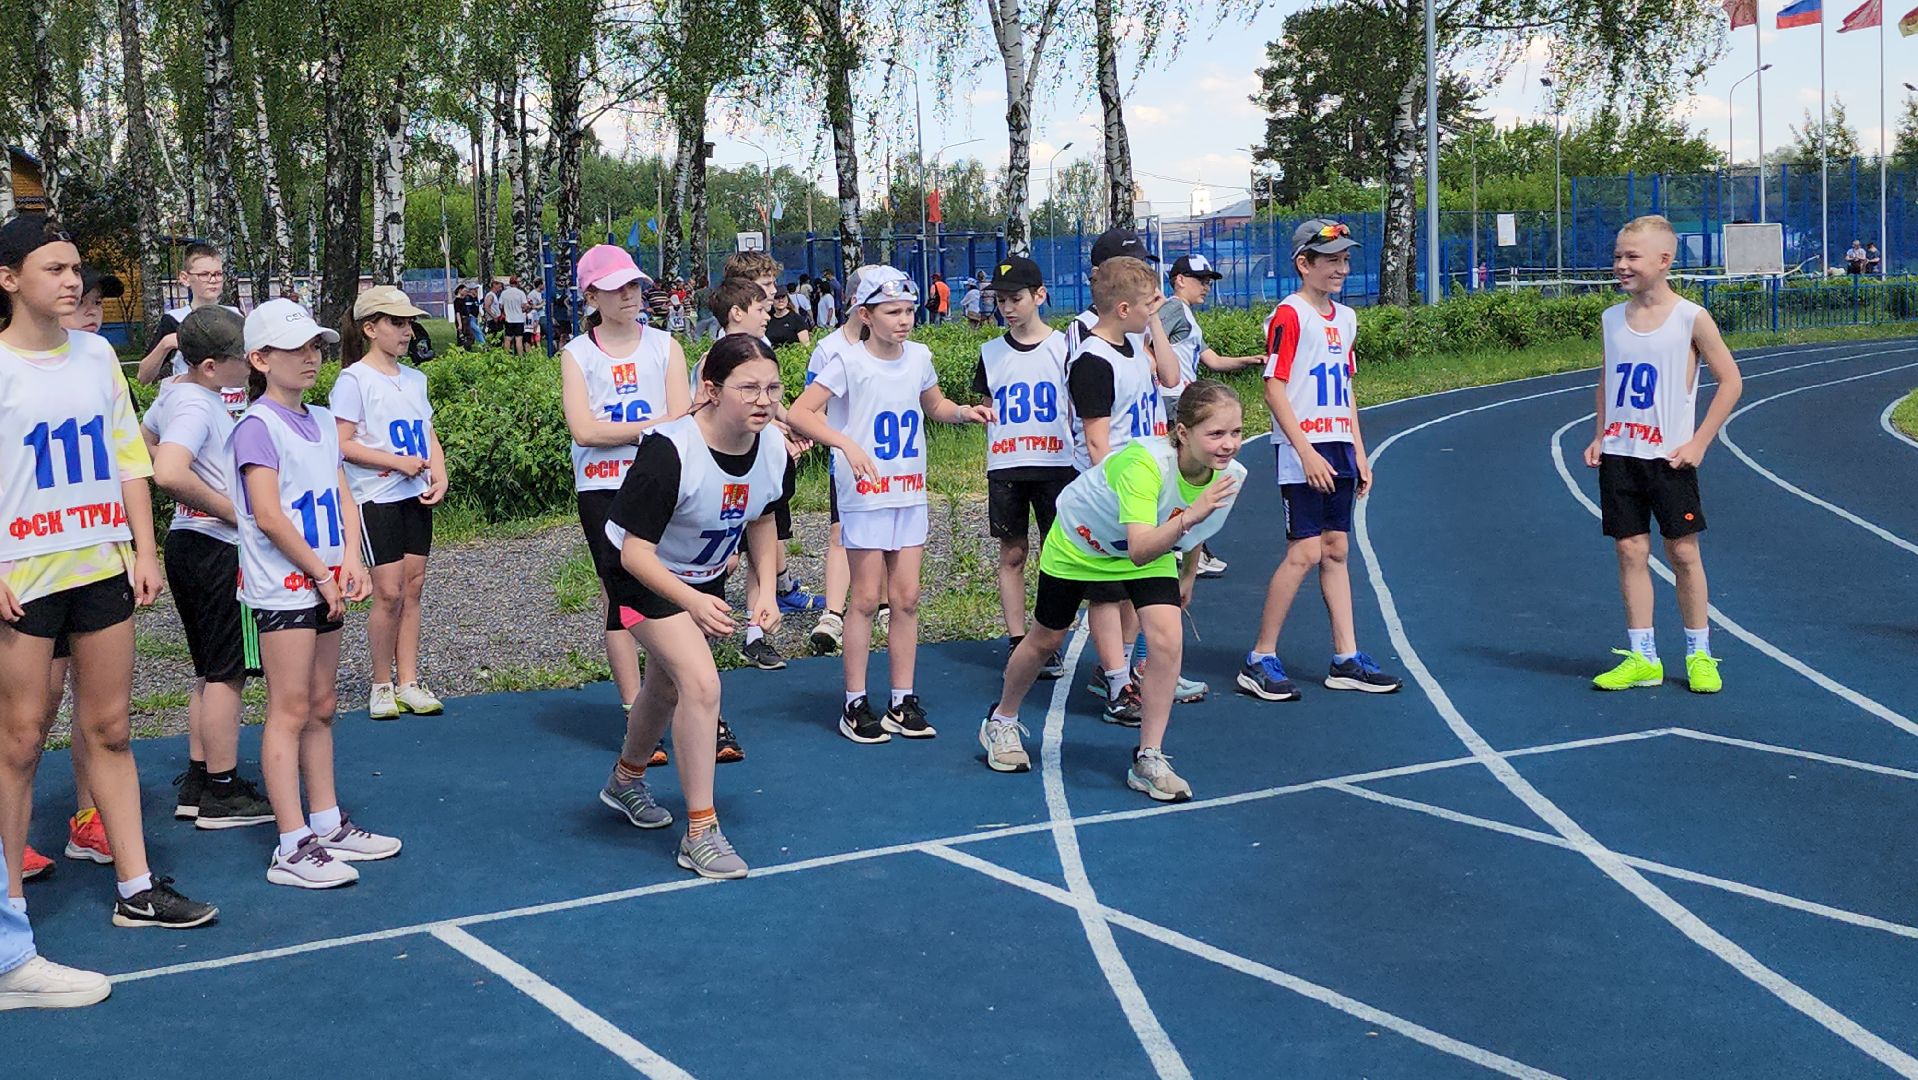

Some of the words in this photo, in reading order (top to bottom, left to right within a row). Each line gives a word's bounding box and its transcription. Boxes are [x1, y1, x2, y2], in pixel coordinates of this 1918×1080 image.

[994, 381, 1058, 425] 139
[1615, 362, 1658, 410] 79
[873, 409, 919, 461] 92
[991, 436, 1017, 455] ФСК
[1299, 416, 1333, 434] ФСК
[23, 414, 112, 490] 111
[584, 460, 620, 479] ФСК
[9, 510, 65, 540] ФСК
[689, 523, 744, 566] 77
